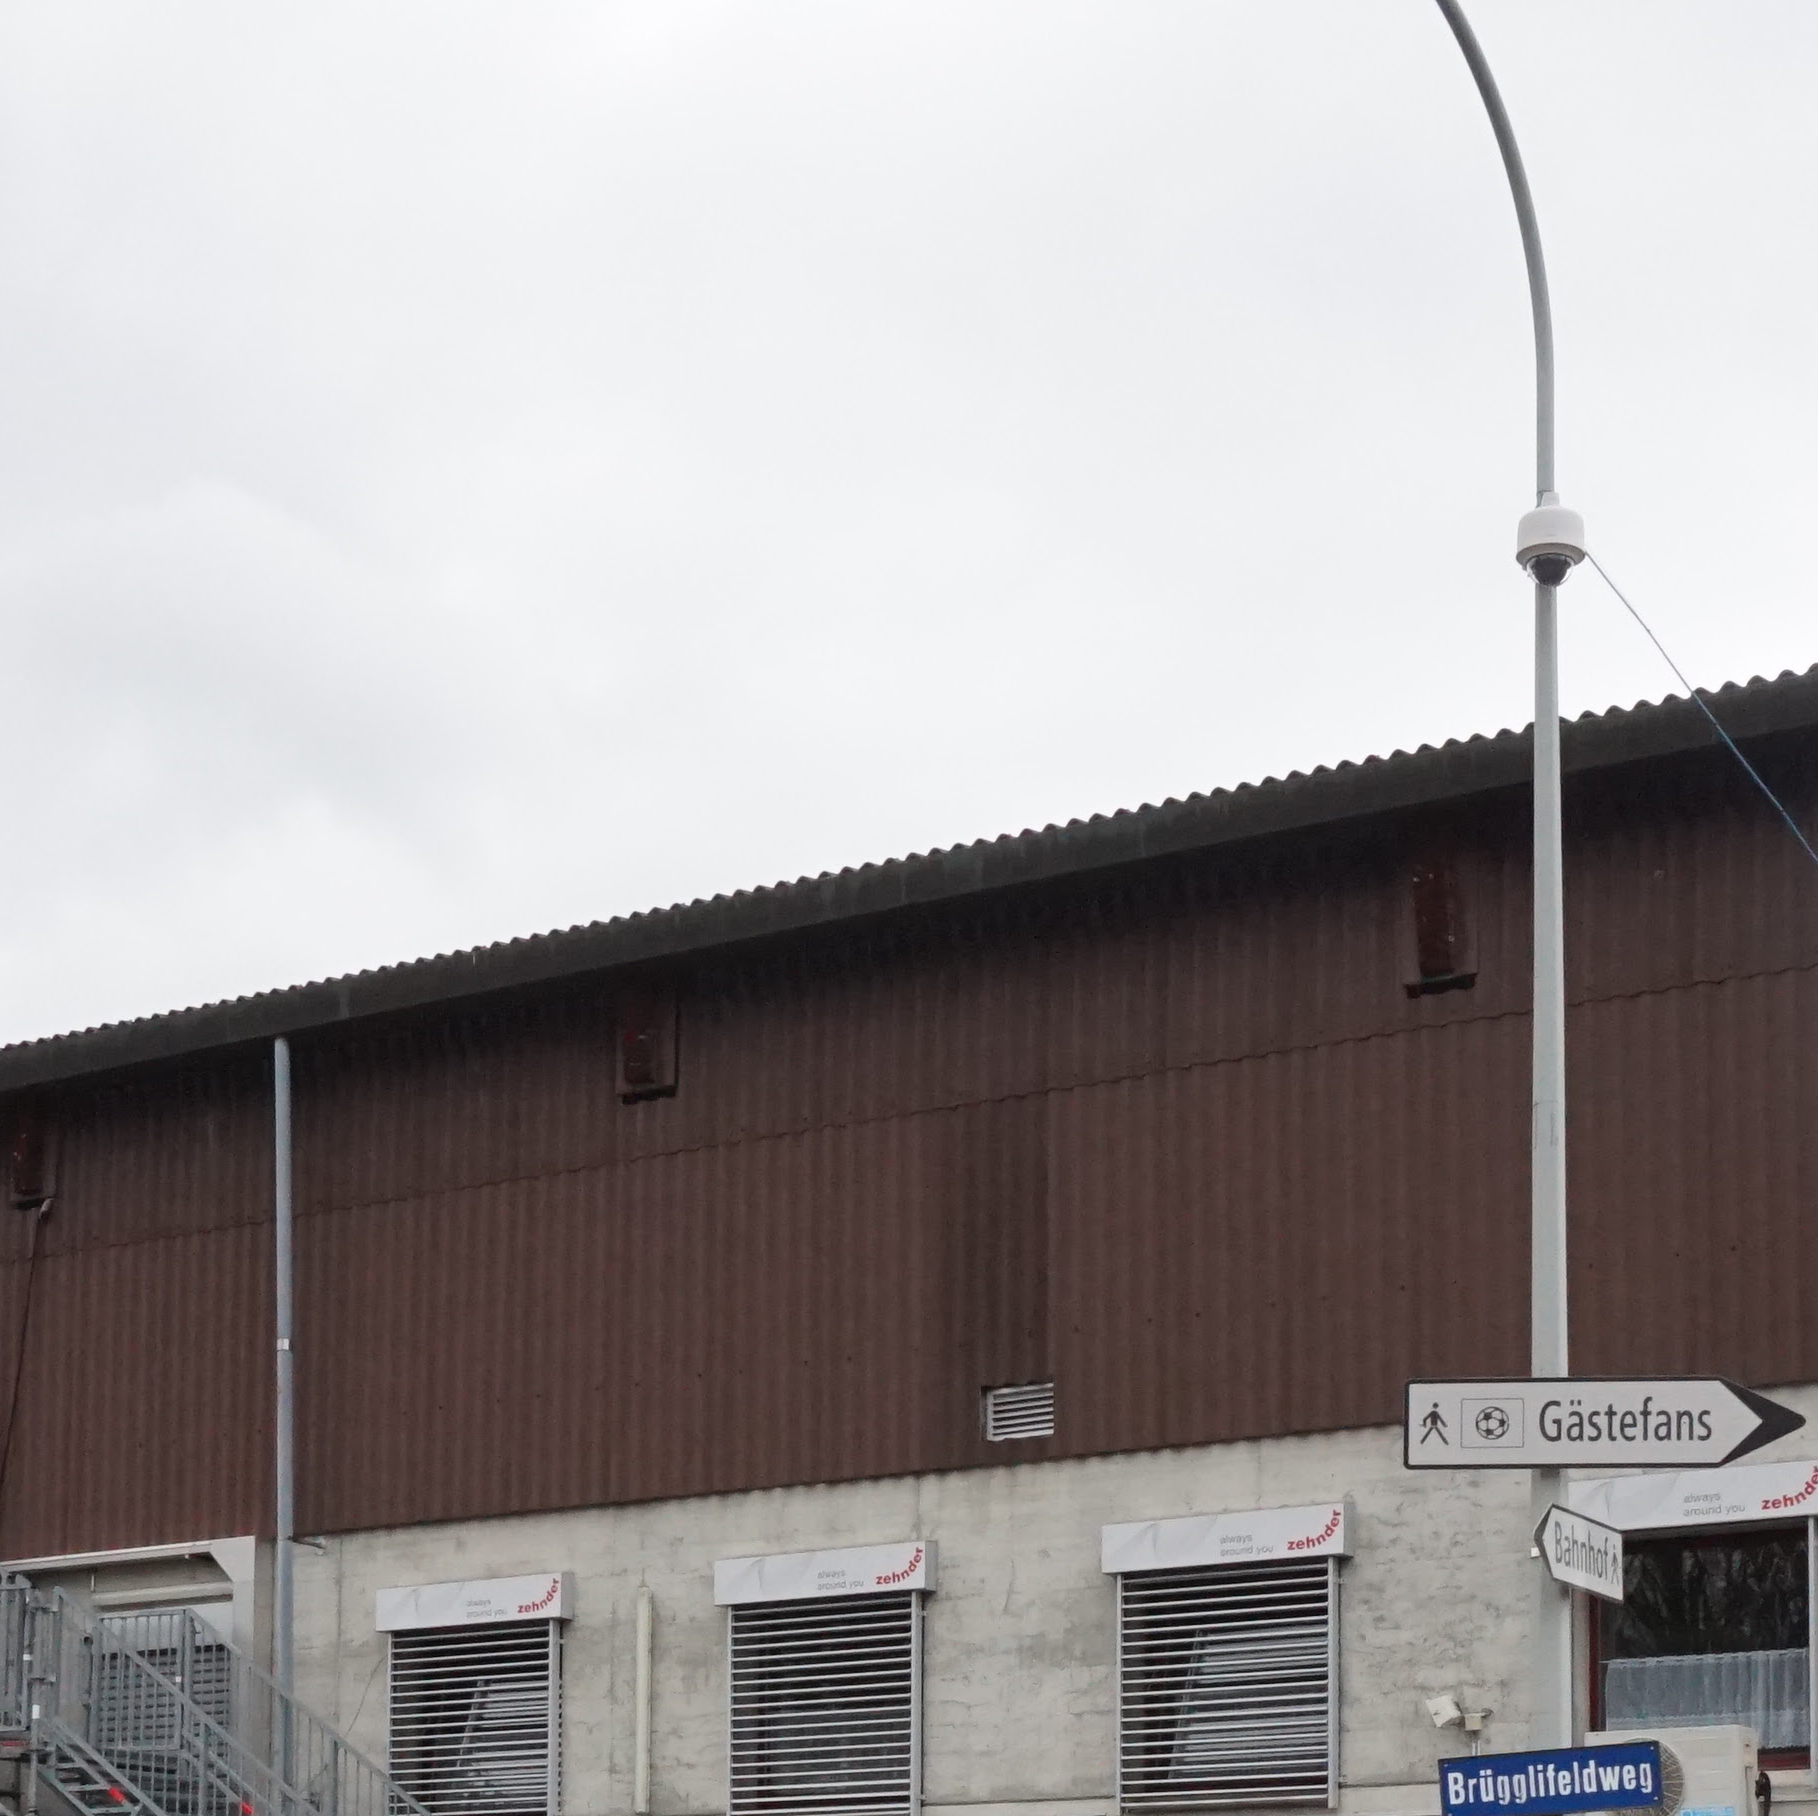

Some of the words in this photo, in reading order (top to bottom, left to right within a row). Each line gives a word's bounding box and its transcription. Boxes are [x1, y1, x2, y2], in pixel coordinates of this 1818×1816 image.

[1539, 1397, 1712, 1442] Gästefans
[1287, 1509, 1341, 1551] zehnder
[1555, 1521, 1608, 1581] Bahnhof
[876, 1546, 923, 1585] zehnder
[517, 1578, 560, 1613] zehnder
[1447, 1760, 1652, 1805] Brügglifeldweg
